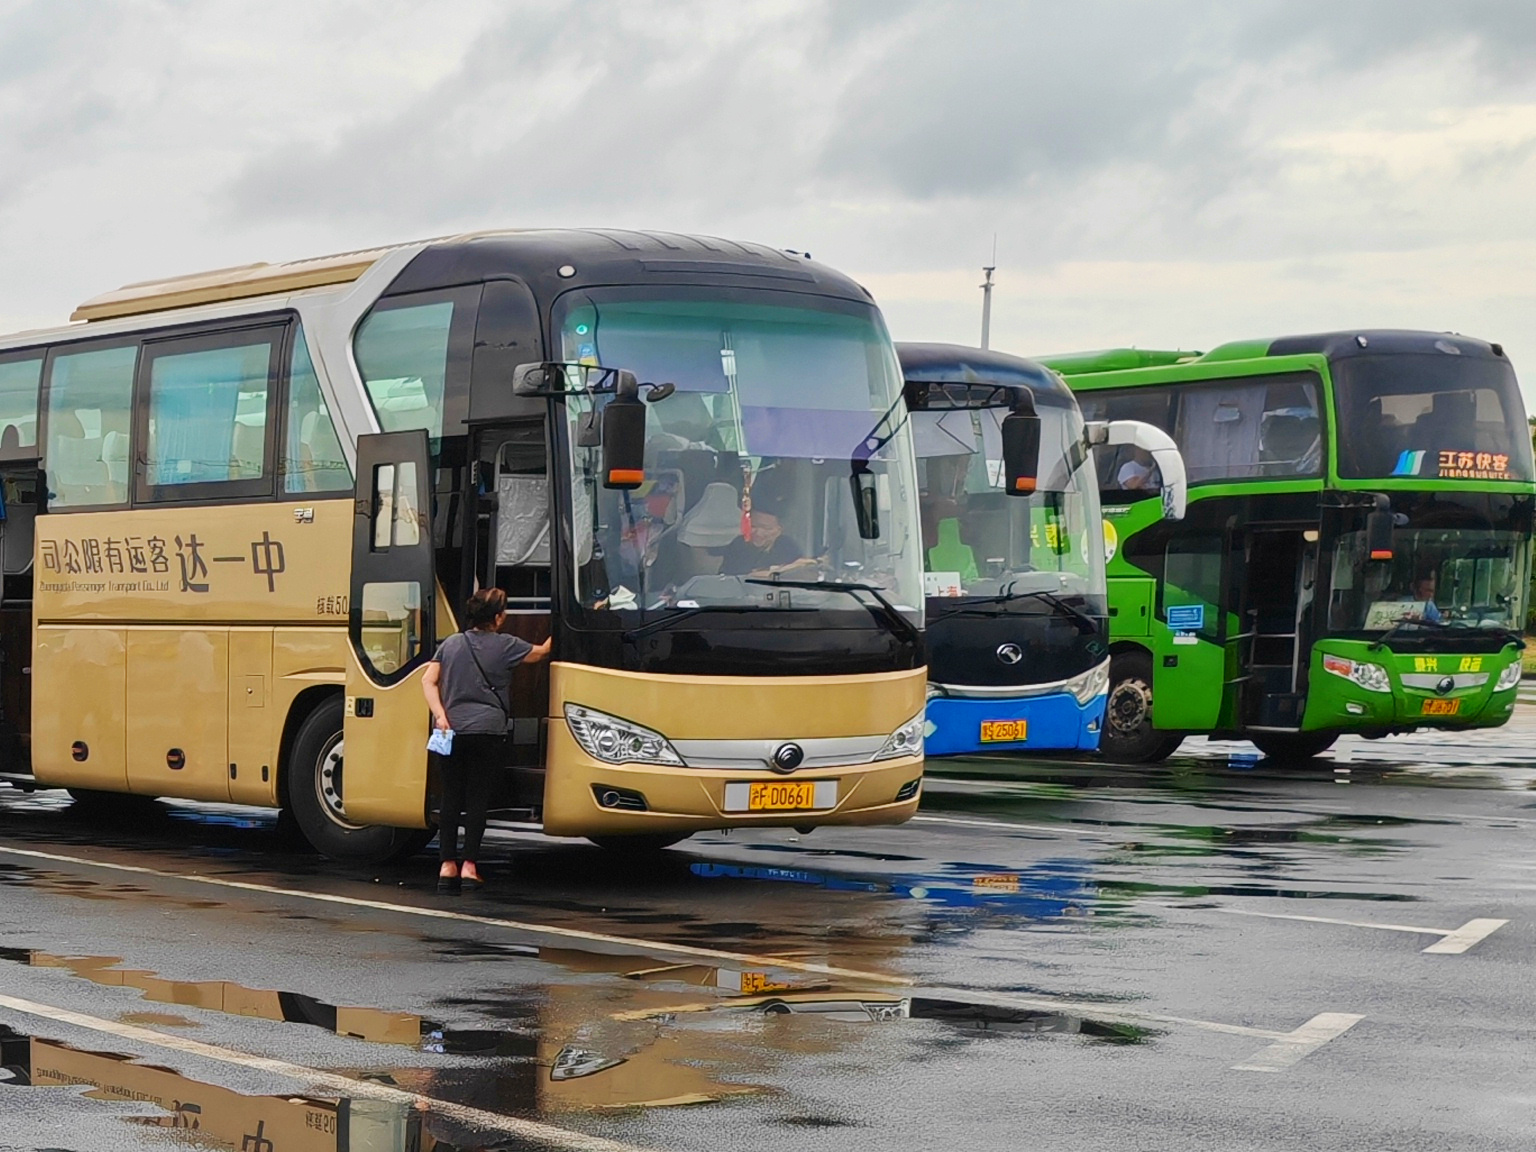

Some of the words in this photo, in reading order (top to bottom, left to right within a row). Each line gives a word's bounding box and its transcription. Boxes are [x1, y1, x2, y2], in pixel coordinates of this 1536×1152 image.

[1439, 451, 1509, 471] 江苏快客
[316, 595, 350, 615] 核载50
